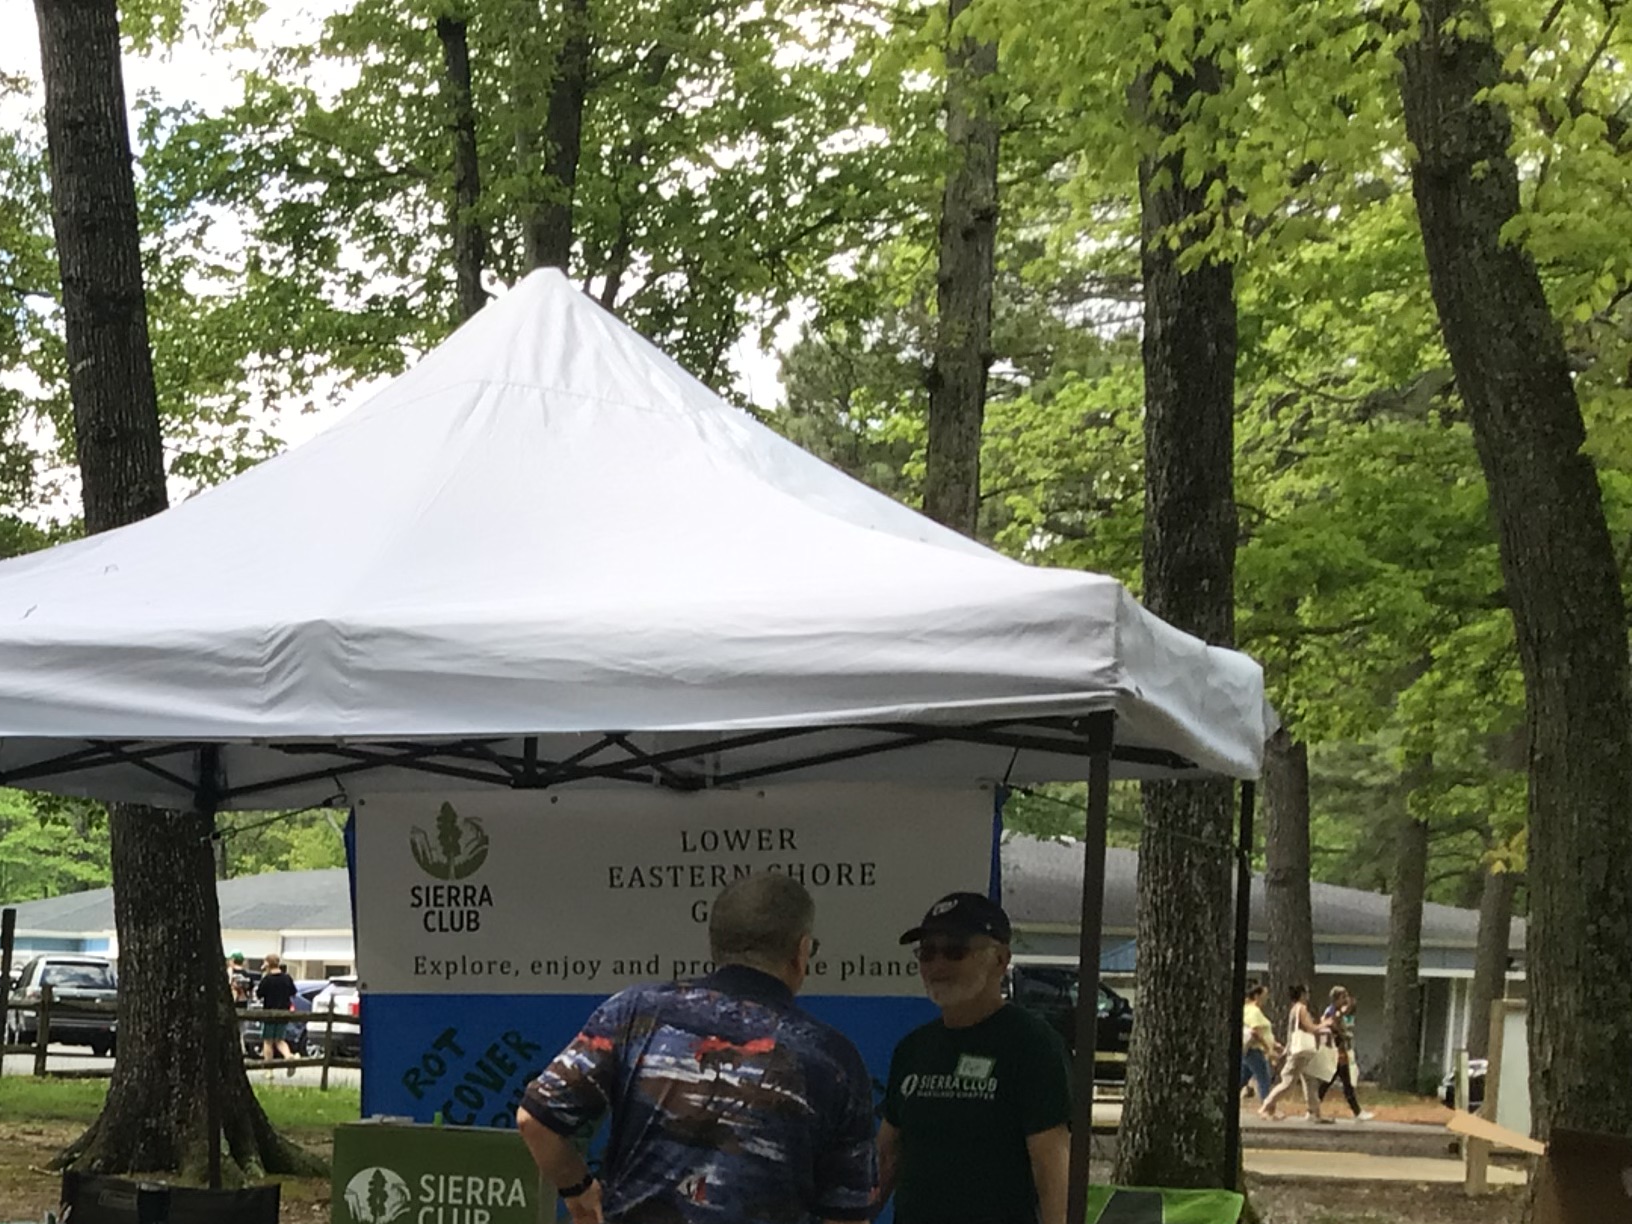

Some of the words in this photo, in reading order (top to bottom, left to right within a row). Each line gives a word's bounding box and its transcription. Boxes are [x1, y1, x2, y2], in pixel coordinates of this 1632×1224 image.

[681, 827, 798, 852] LOWER
[608, 864, 751, 889] EASTERN
[410, 884, 494, 908] SIERRA
[423, 909, 480, 933] CLUB
[413, 955, 520, 981] Explore,
[530, 955, 601, 980] enjoy
[612, 955, 660, 976] and
[840, 954, 919, 982] plane
[402, 1026, 465, 1099] ROT
[442, 1029, 542, 1125] COVER
[919, 1074, 960, 1090] SIERRA
[963, 1077, 998, 1092] CLUB
[419, 1174, 526, 1208] SIERRA
